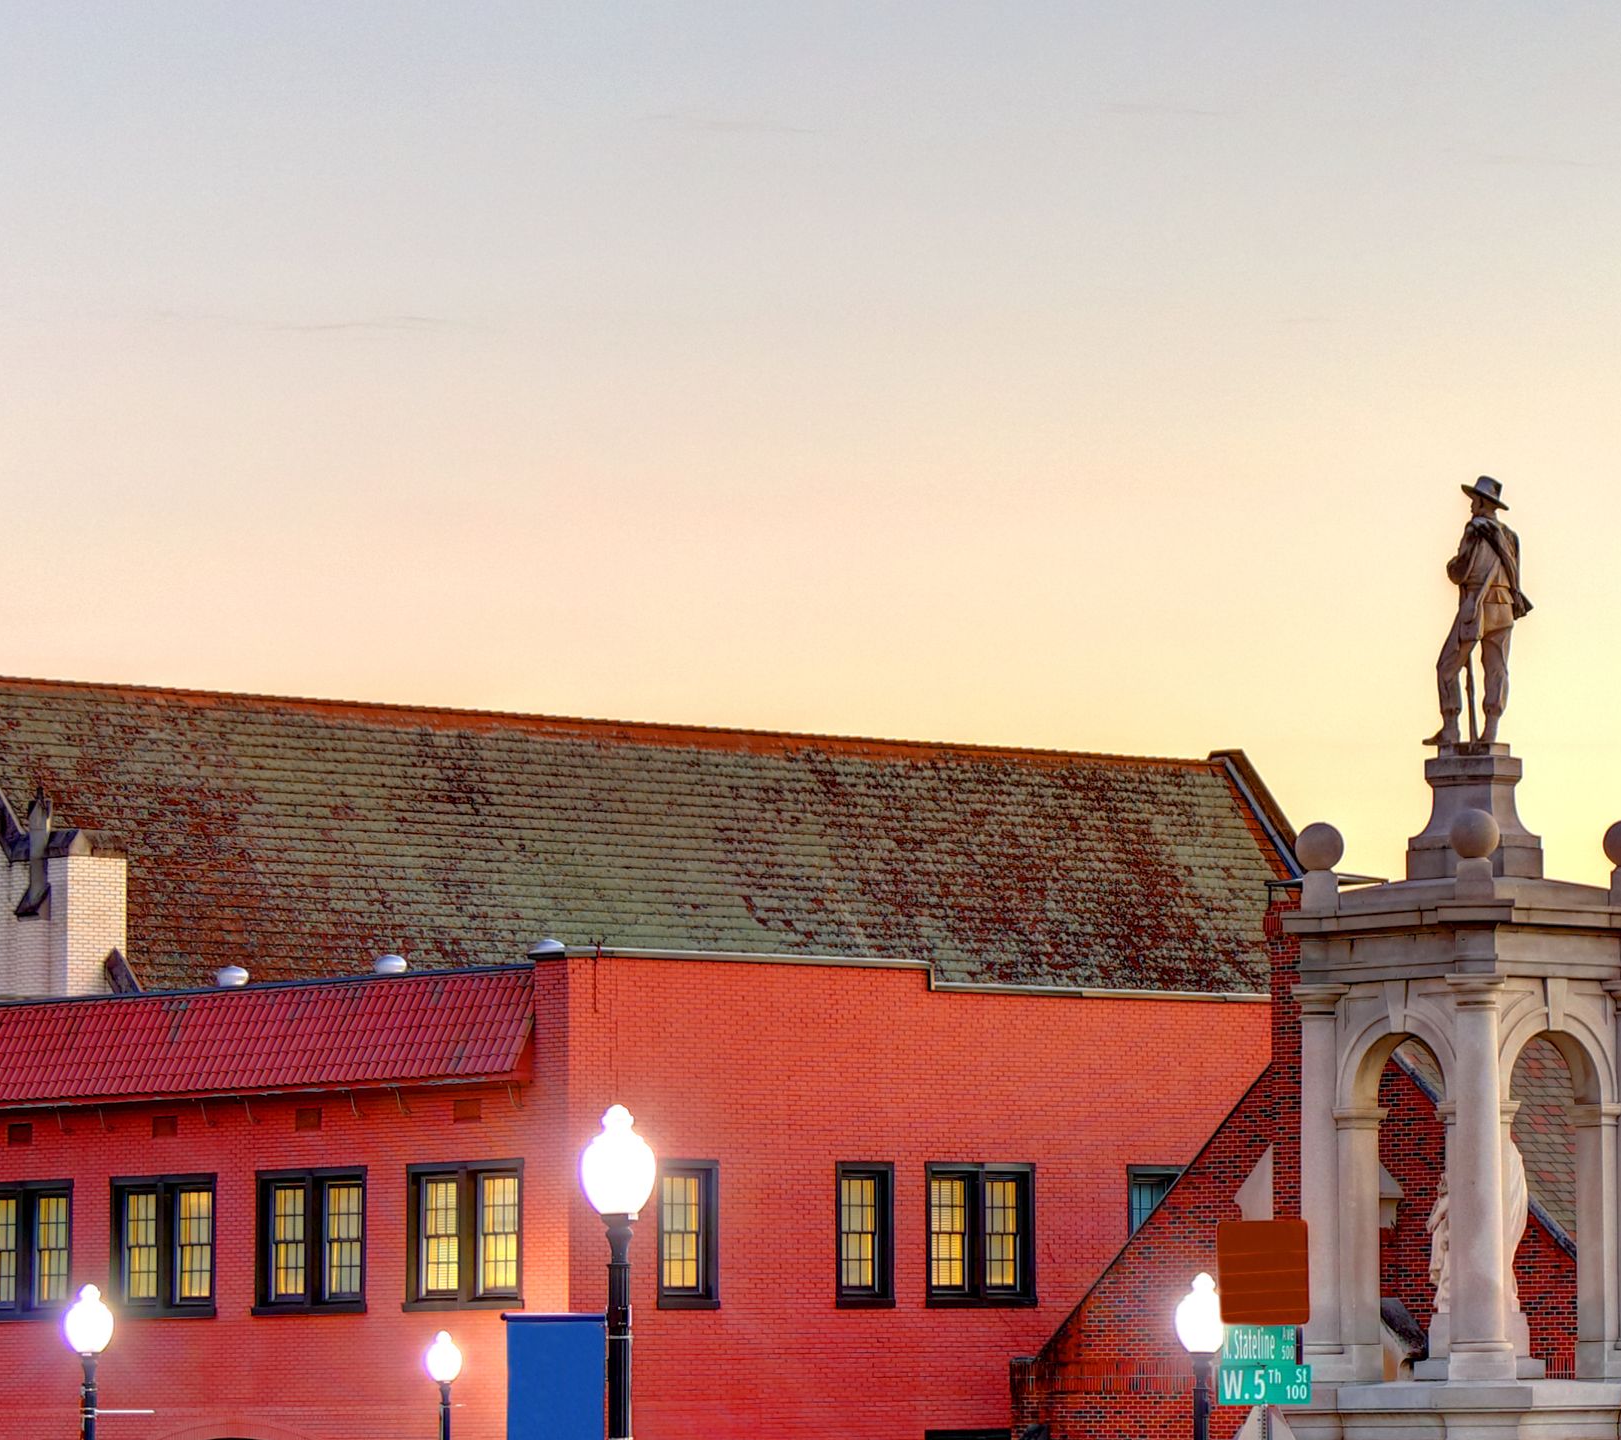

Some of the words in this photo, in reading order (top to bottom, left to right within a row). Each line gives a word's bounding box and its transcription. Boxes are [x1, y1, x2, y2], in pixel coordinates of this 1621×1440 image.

[1222, 1329, 1232, 1359] N.
[1234, 1327, 1276, 1360] Stateline
[1282, 1327, 1295, 1341] Ave
[1281, 1345, 1295, 1360] 500
[1222, 1369, 1250, 1400] W.
[1295, 1368, 1308, 1383] St
[1285, 1384, 1308, 1400] 100
